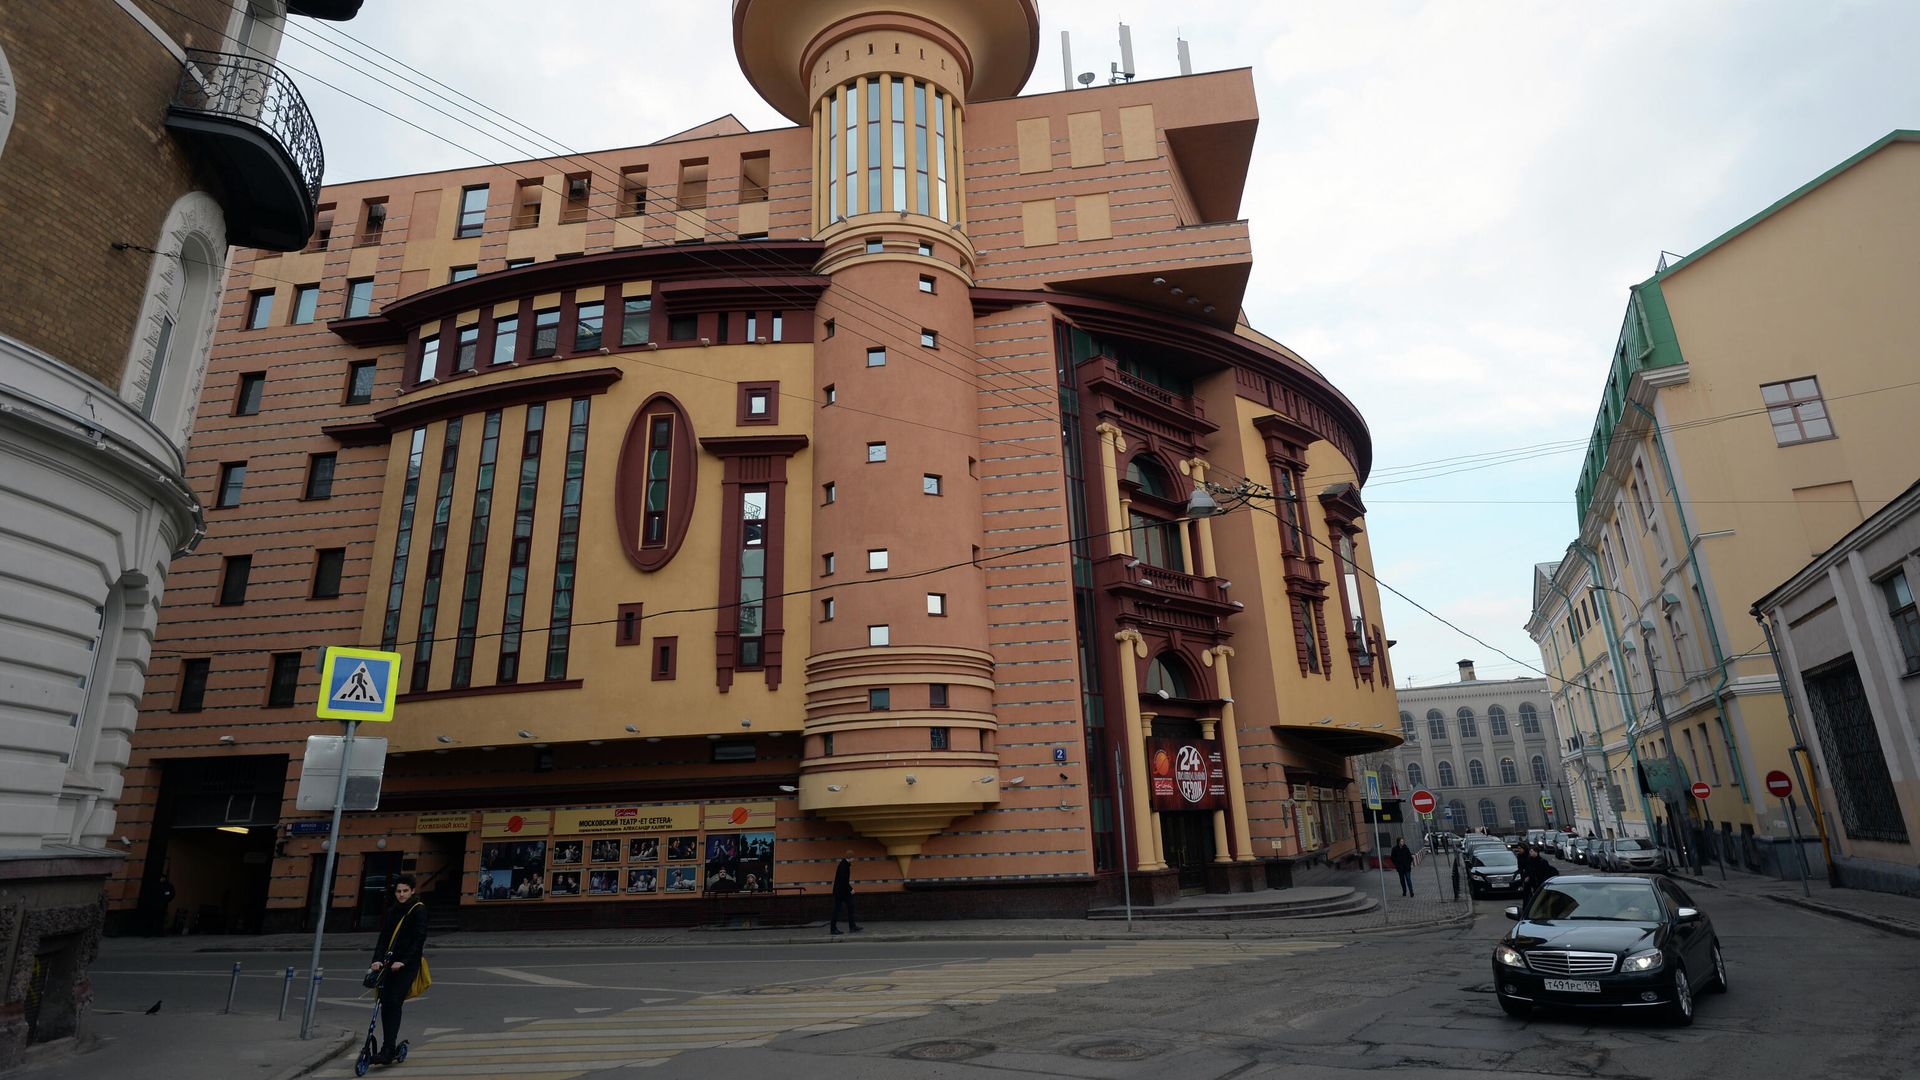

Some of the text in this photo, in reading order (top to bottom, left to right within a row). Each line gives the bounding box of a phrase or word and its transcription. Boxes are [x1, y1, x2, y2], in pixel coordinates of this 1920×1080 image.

[1056, 749, 1064, 759] 2
[1180, 747, 1201, 771] 24
[1182, 781, 1203, 800] СЕЗОН
[579, 818, 618, 827] МОСКОВСКИЙ
